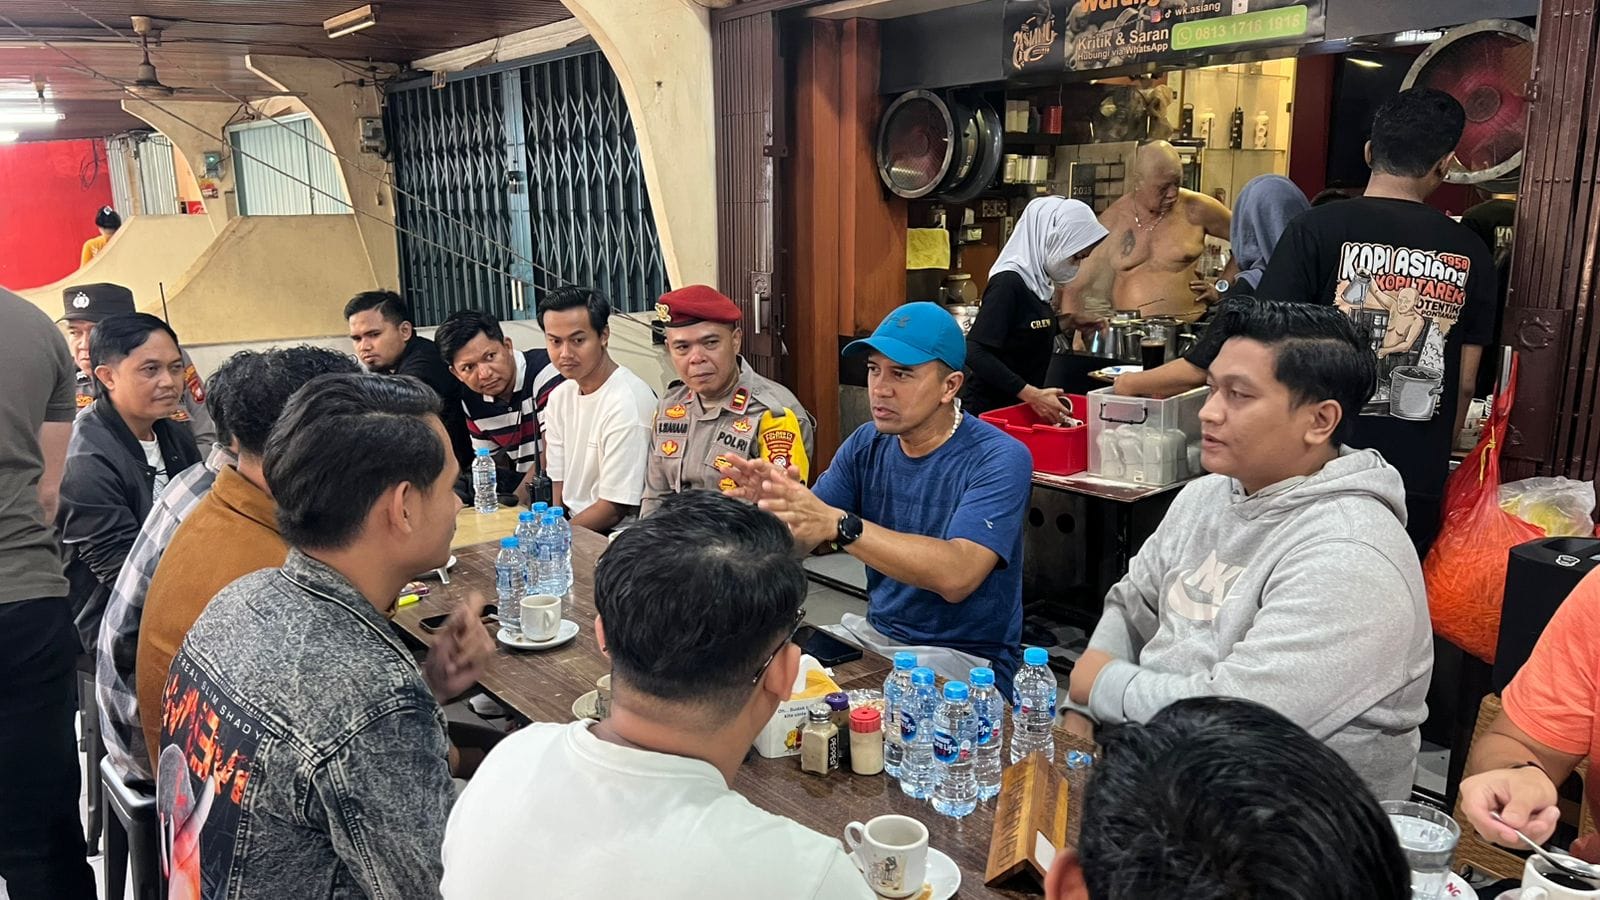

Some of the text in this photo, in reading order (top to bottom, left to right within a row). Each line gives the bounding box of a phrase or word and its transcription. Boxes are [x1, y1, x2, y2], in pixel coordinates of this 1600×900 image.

[1078, 28, 1169, 50] Kritik & Saran
[1078, 41, 1169, 60] Hubungi via WhatsApp
[1341, 243, 1390, 281] KOPI
[1440, 254, 1468, 271] 1958
[1415, 278, 1466, 305] TAREK
[716, 431, 748, 452] POLRI
[180, 659, 263, 741] REAL SLIM SHADY
